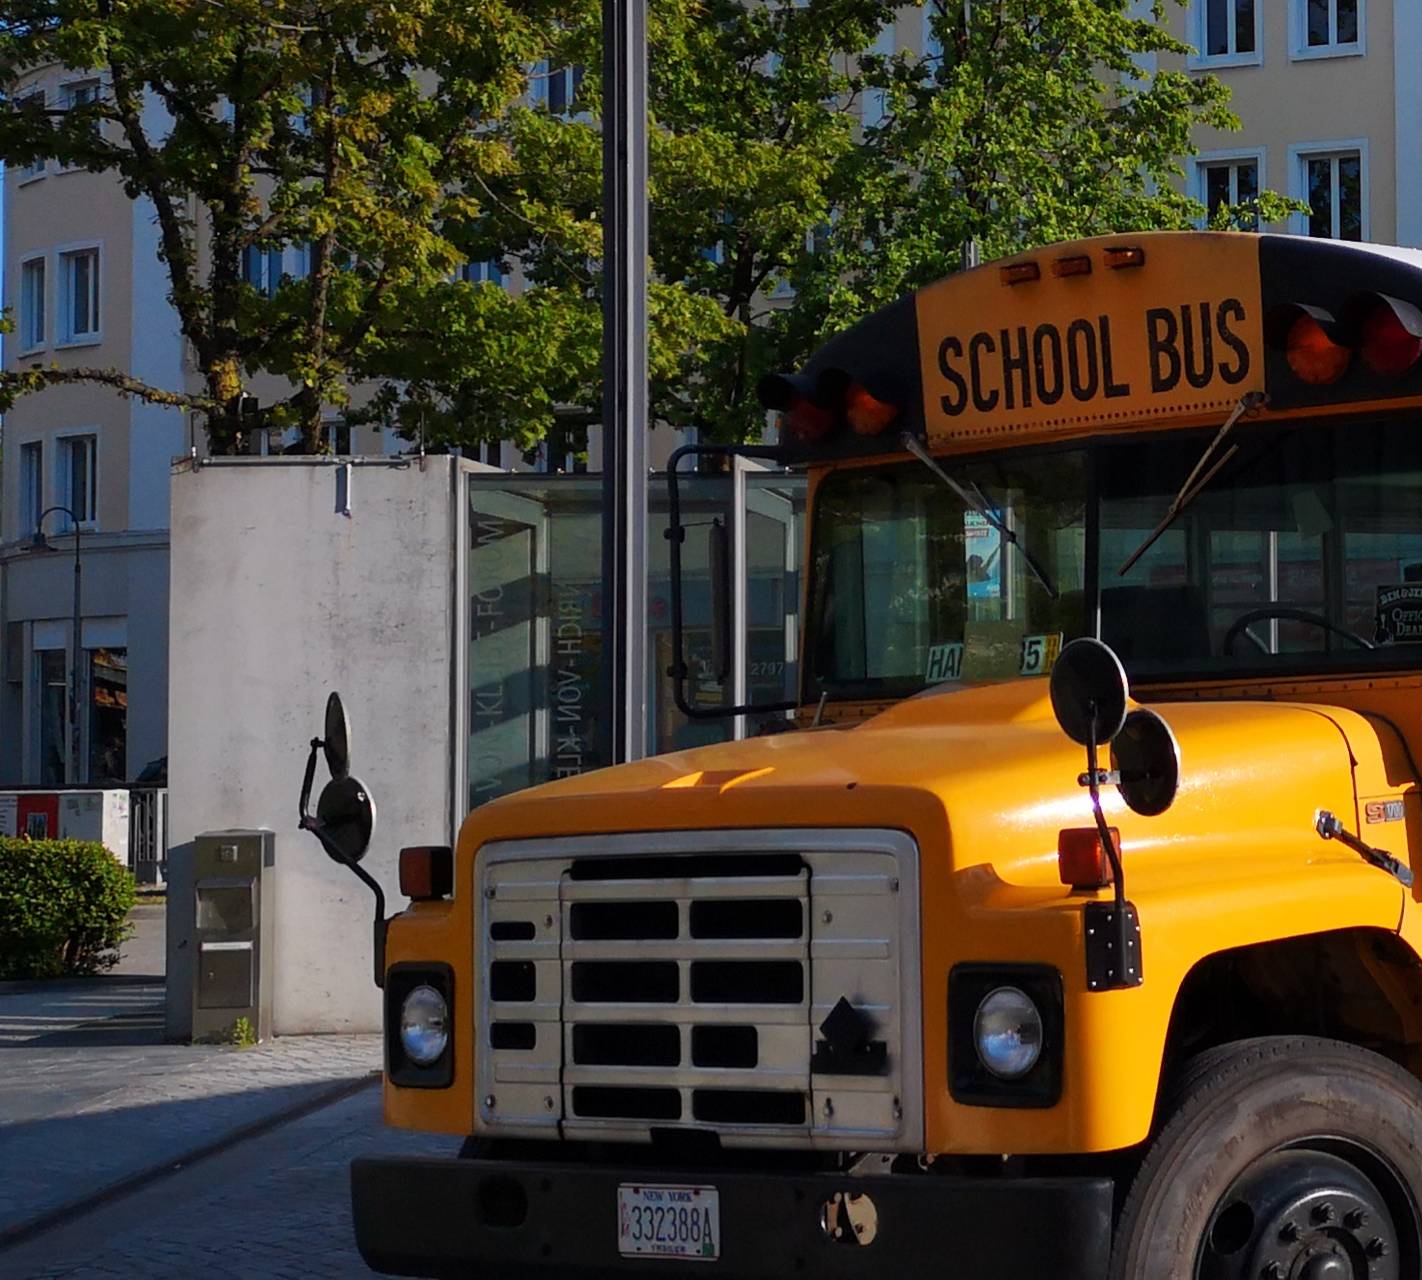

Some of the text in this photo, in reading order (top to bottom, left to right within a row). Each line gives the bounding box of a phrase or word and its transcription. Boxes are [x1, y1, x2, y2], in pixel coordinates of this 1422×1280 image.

[938, 298, 1250, 416] SCHOOL BUS
[643, 1191, 693, 1203] NEW YORK
[632, 1206, 713, 1244] 332388A
